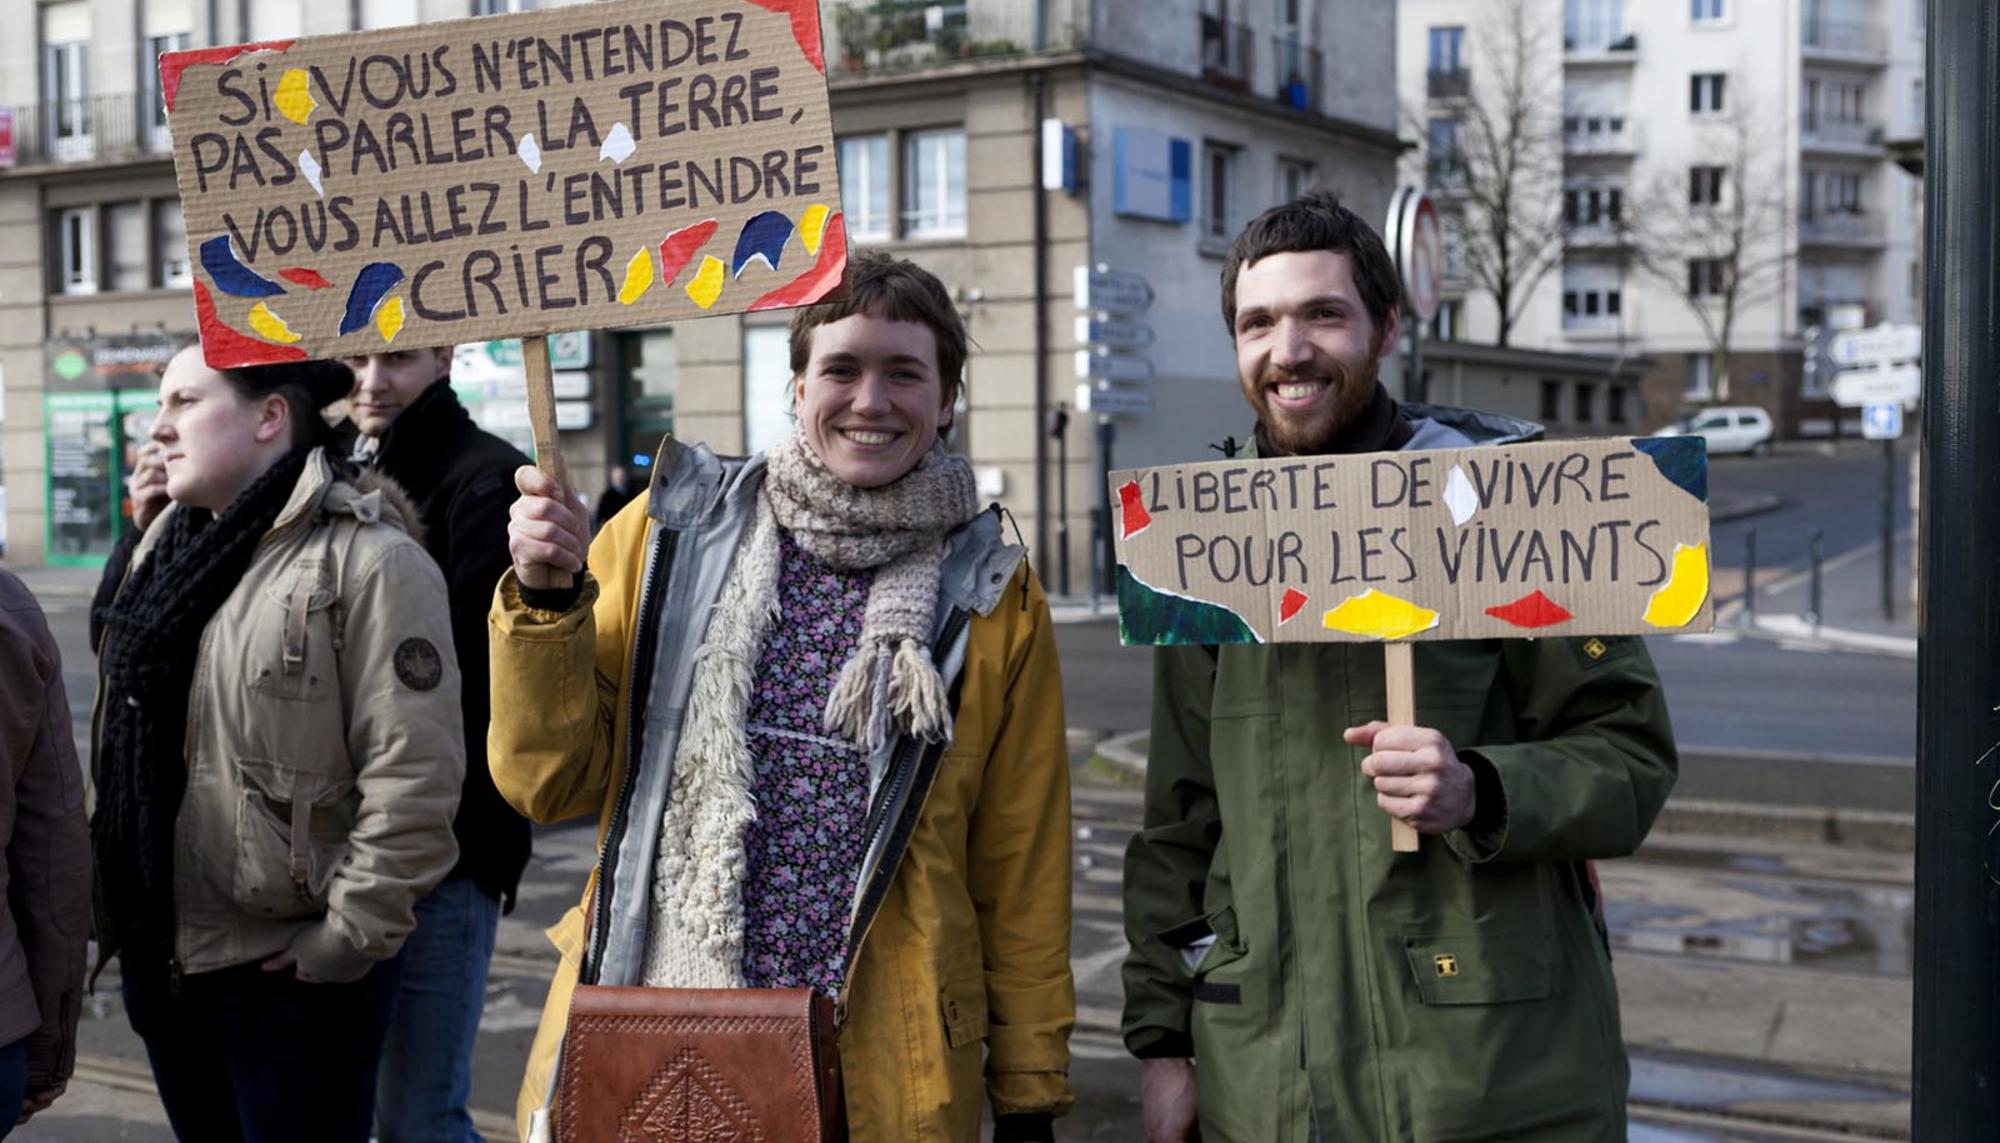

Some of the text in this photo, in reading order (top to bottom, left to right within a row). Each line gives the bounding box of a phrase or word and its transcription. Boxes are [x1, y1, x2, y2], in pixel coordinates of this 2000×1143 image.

[309, 45, 457, 118] VOUS
[472, 13, 750, 95] N'ENTENDEZ
[190, 66, 804, 193] PAS PARLER LA TERRE,
[222, 144, 825, 264] VOUS ALLEZ L'ENTENDRE
[1371, 457, 1433, 509] DE
[1176, 530, 1308, 590] POUR
[1330, 527, 1417, 584] LES
